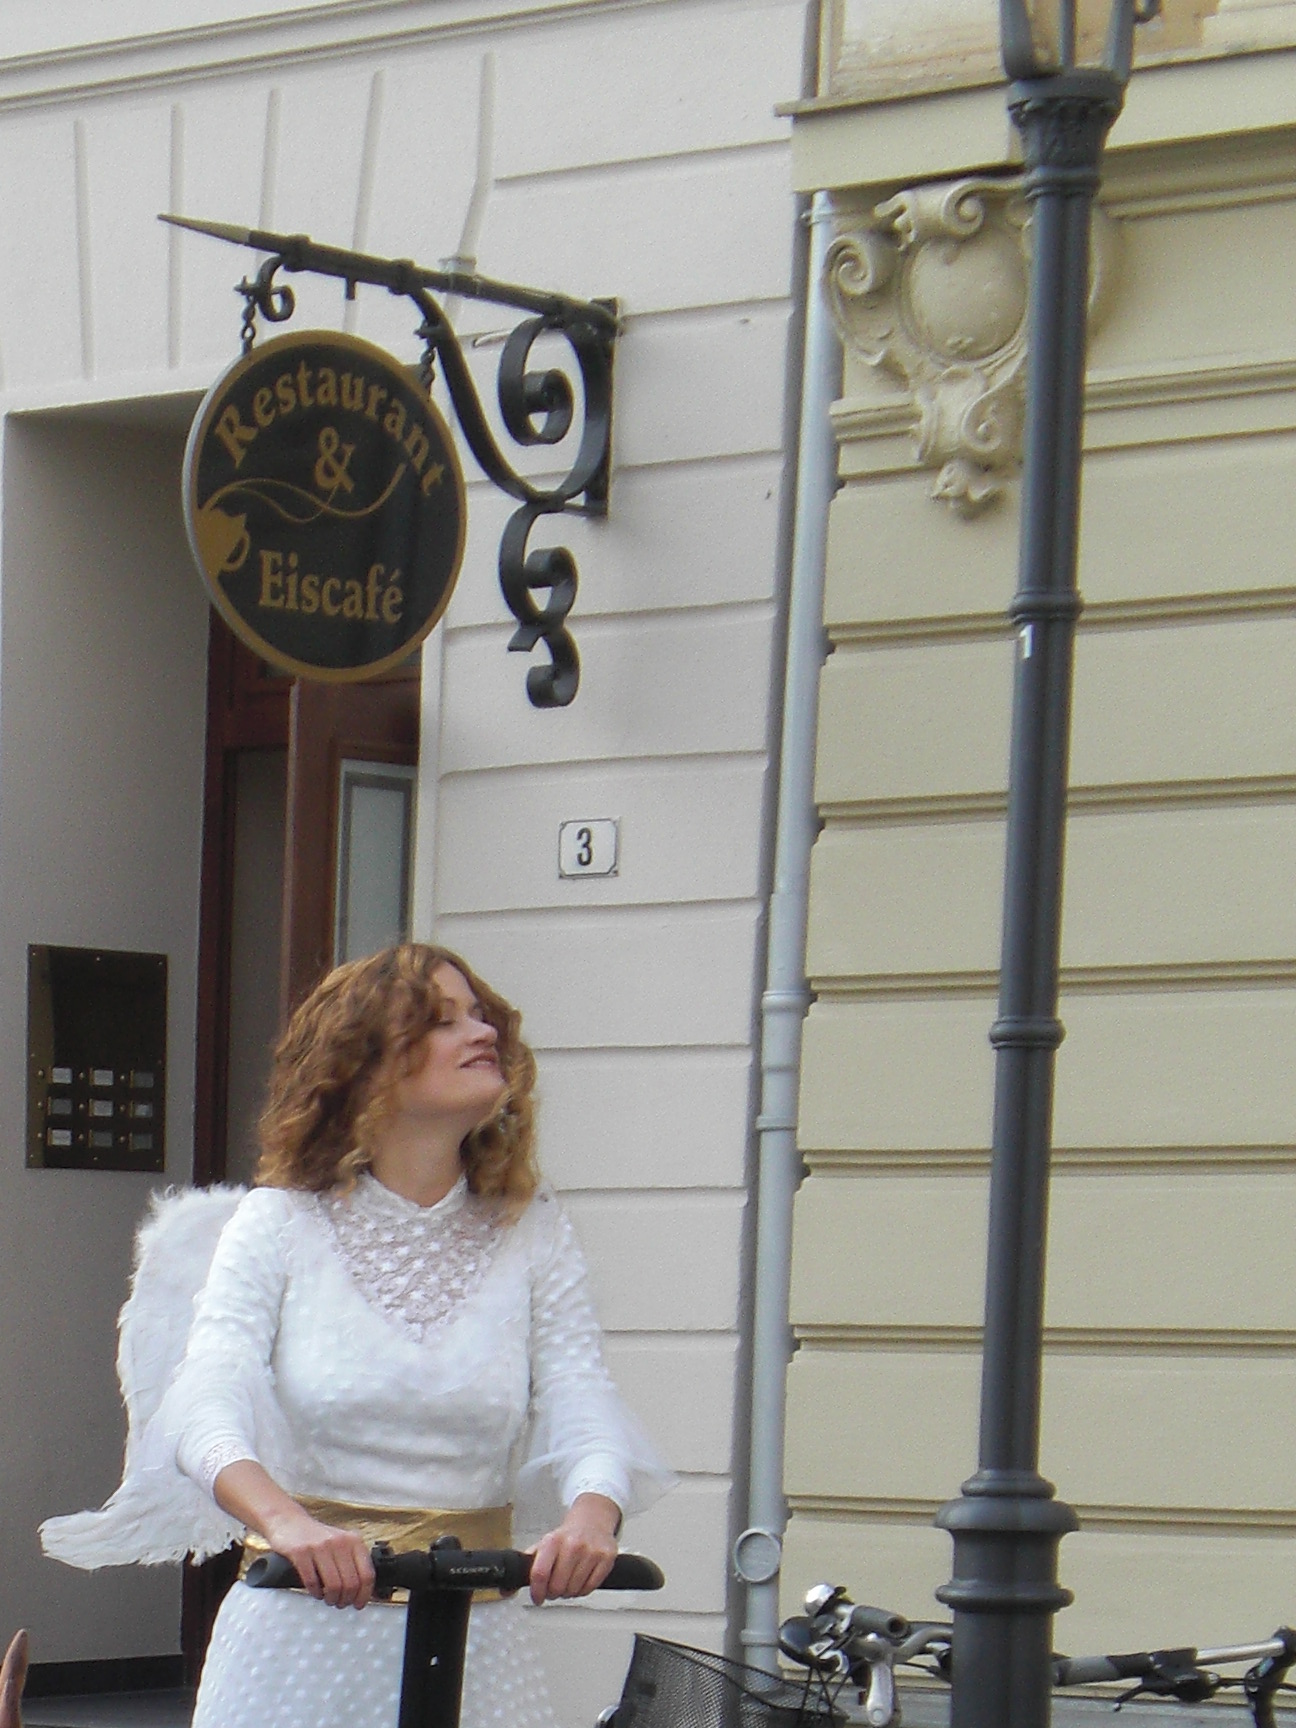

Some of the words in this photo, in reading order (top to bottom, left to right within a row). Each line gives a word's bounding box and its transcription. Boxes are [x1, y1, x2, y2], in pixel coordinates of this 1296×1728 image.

[214, 360, 444, 496] Restaurant
[314, 426, 356, 494] &
[258, 549, 404, 624] Eiscafé
[576, 826, 592, 867] 3
